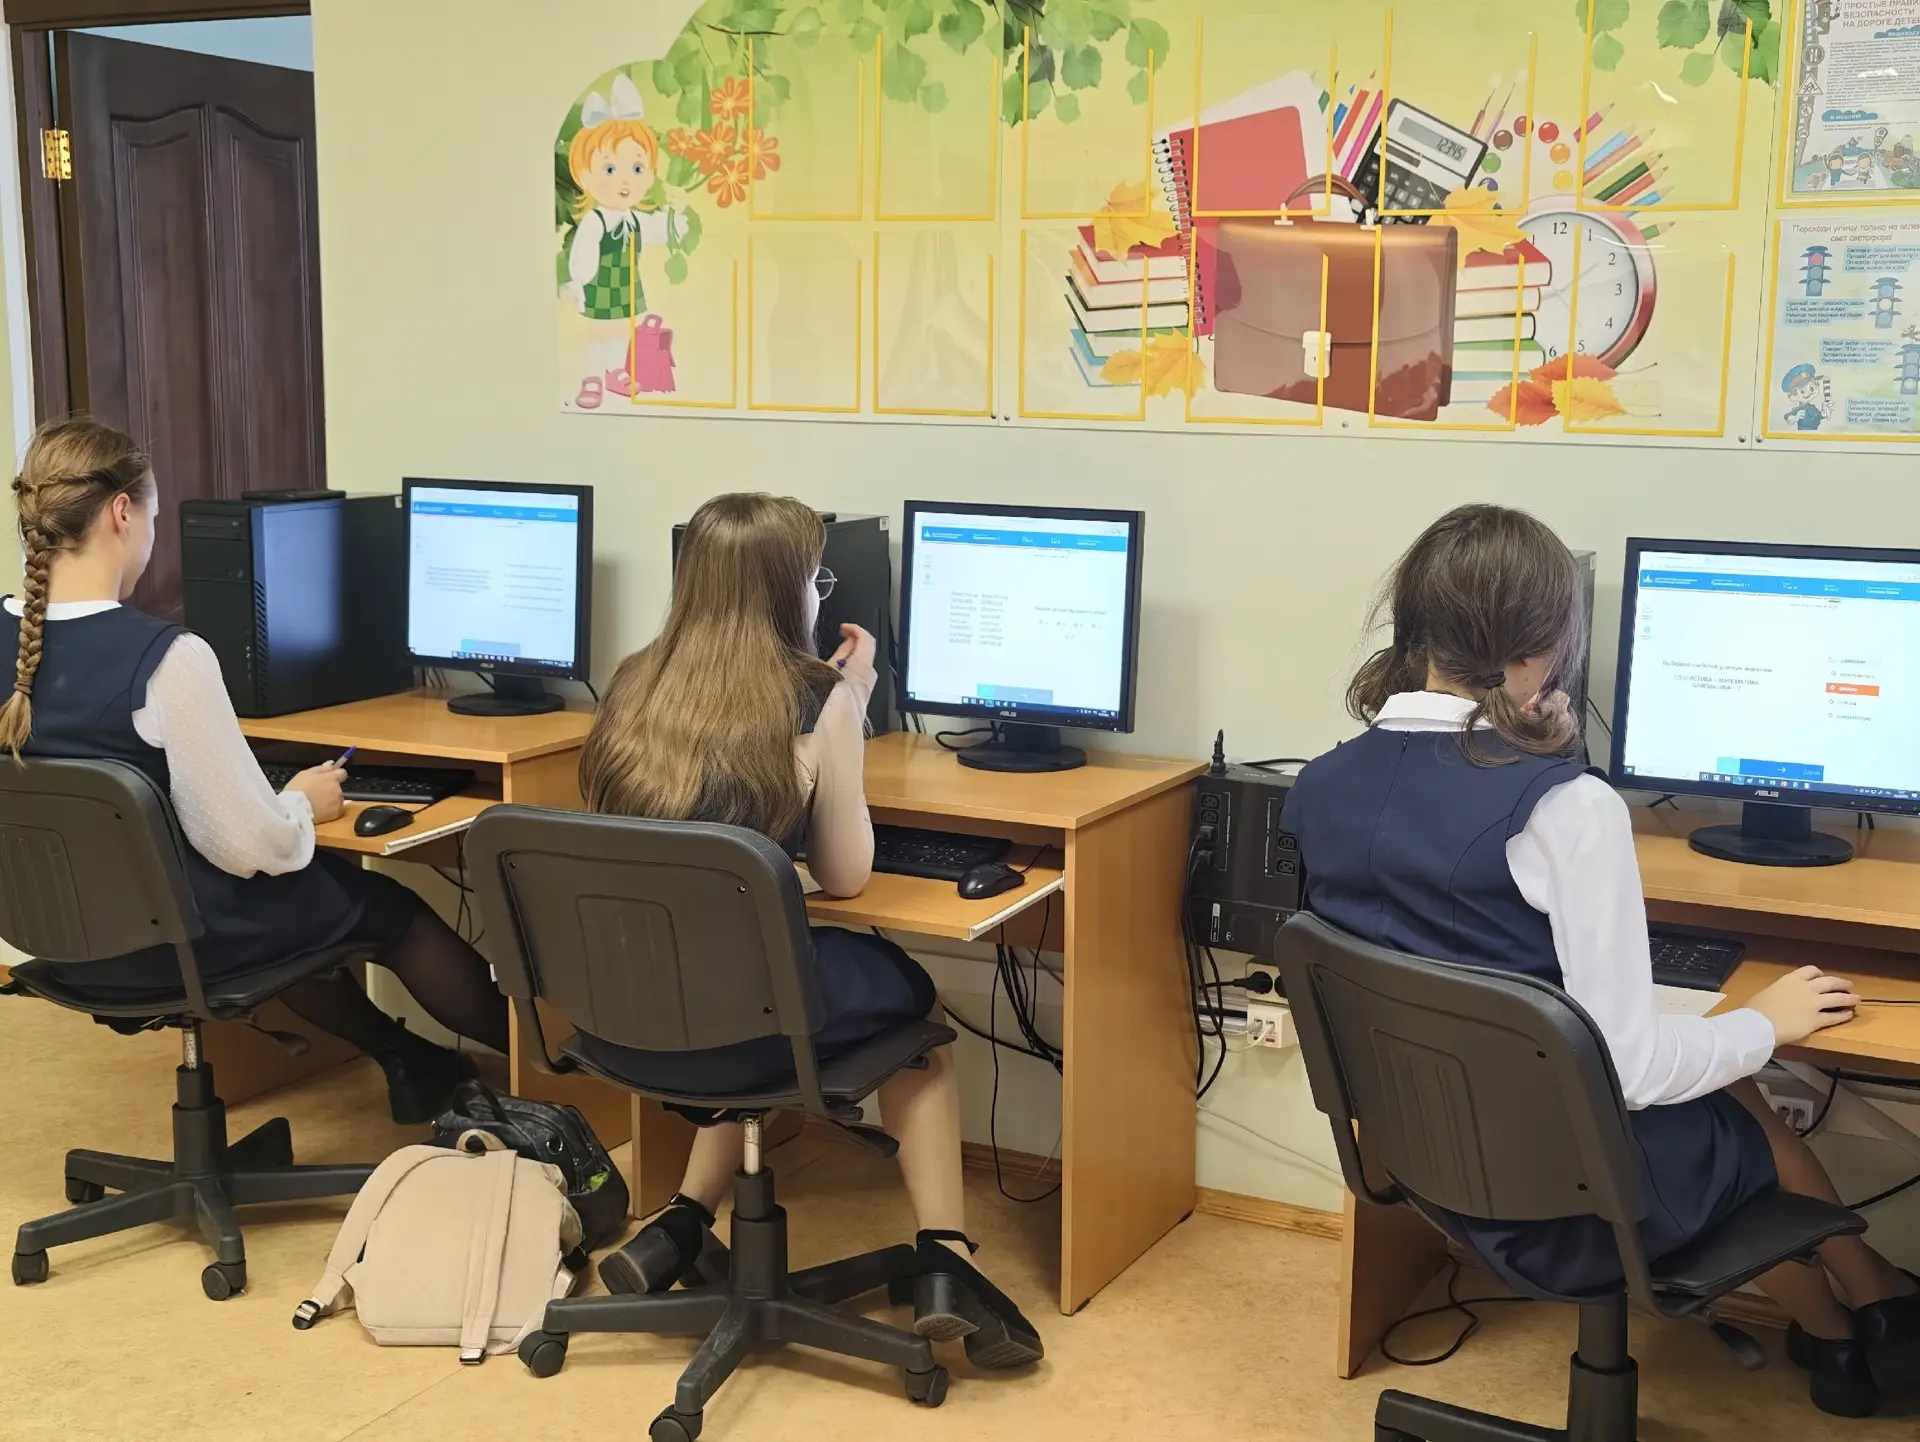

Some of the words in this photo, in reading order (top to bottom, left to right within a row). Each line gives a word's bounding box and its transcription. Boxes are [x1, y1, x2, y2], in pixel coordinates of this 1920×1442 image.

[1844, 8, 1914, 18] БЕЗОПАСНОСТИ
[1857, 18, 1892, 28] ДОРОГЕ
[1436, 136, 1464, 160] 12345
[1553, 222, 1568, 234] 12
[1792, 225, 1831, 234] Переходи
[1834, 225, 1858, 233] улицу
[1588, 228, 1592, 241] 1
[1608, 252, 1616, 265] 2
[1614, 283, 1622, 296] 3
[1605, 317, 1613, 329] 4
[1548, 345, 1557, 357] 6
[1578, 340, 1585, 352] 5
